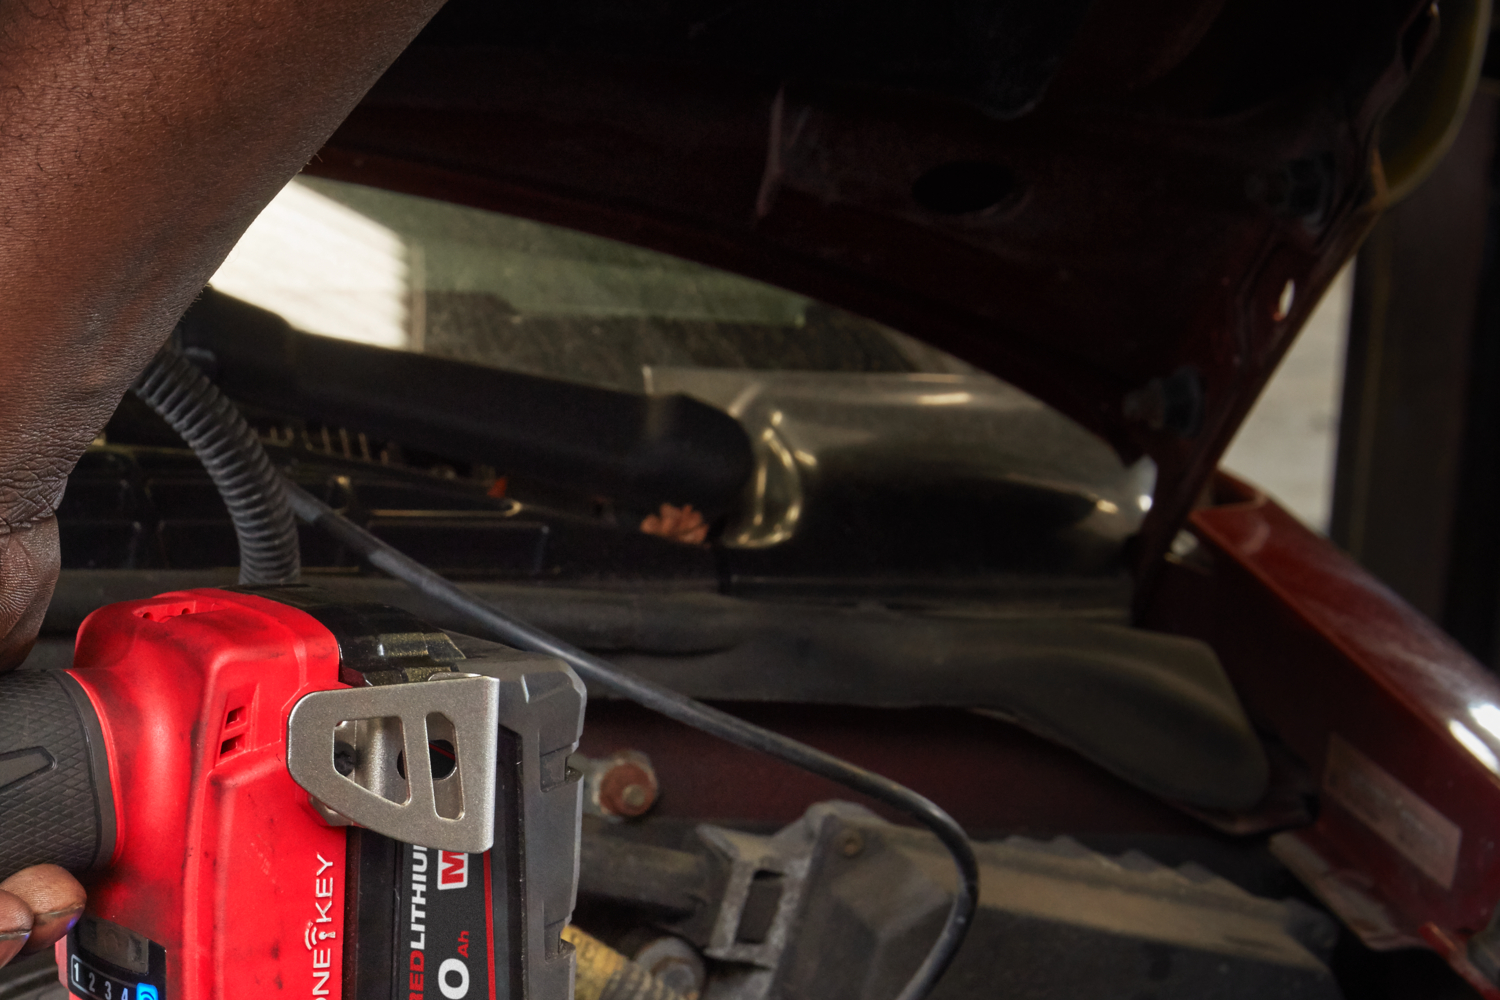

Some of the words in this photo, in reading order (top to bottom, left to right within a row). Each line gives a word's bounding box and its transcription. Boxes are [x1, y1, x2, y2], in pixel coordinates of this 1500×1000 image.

[457, 931, 470, 958] Ah
[73, 962, 80, 982] 1
[88, 972, 96, 993] 2
[104, 981, 112, 1000] 3
